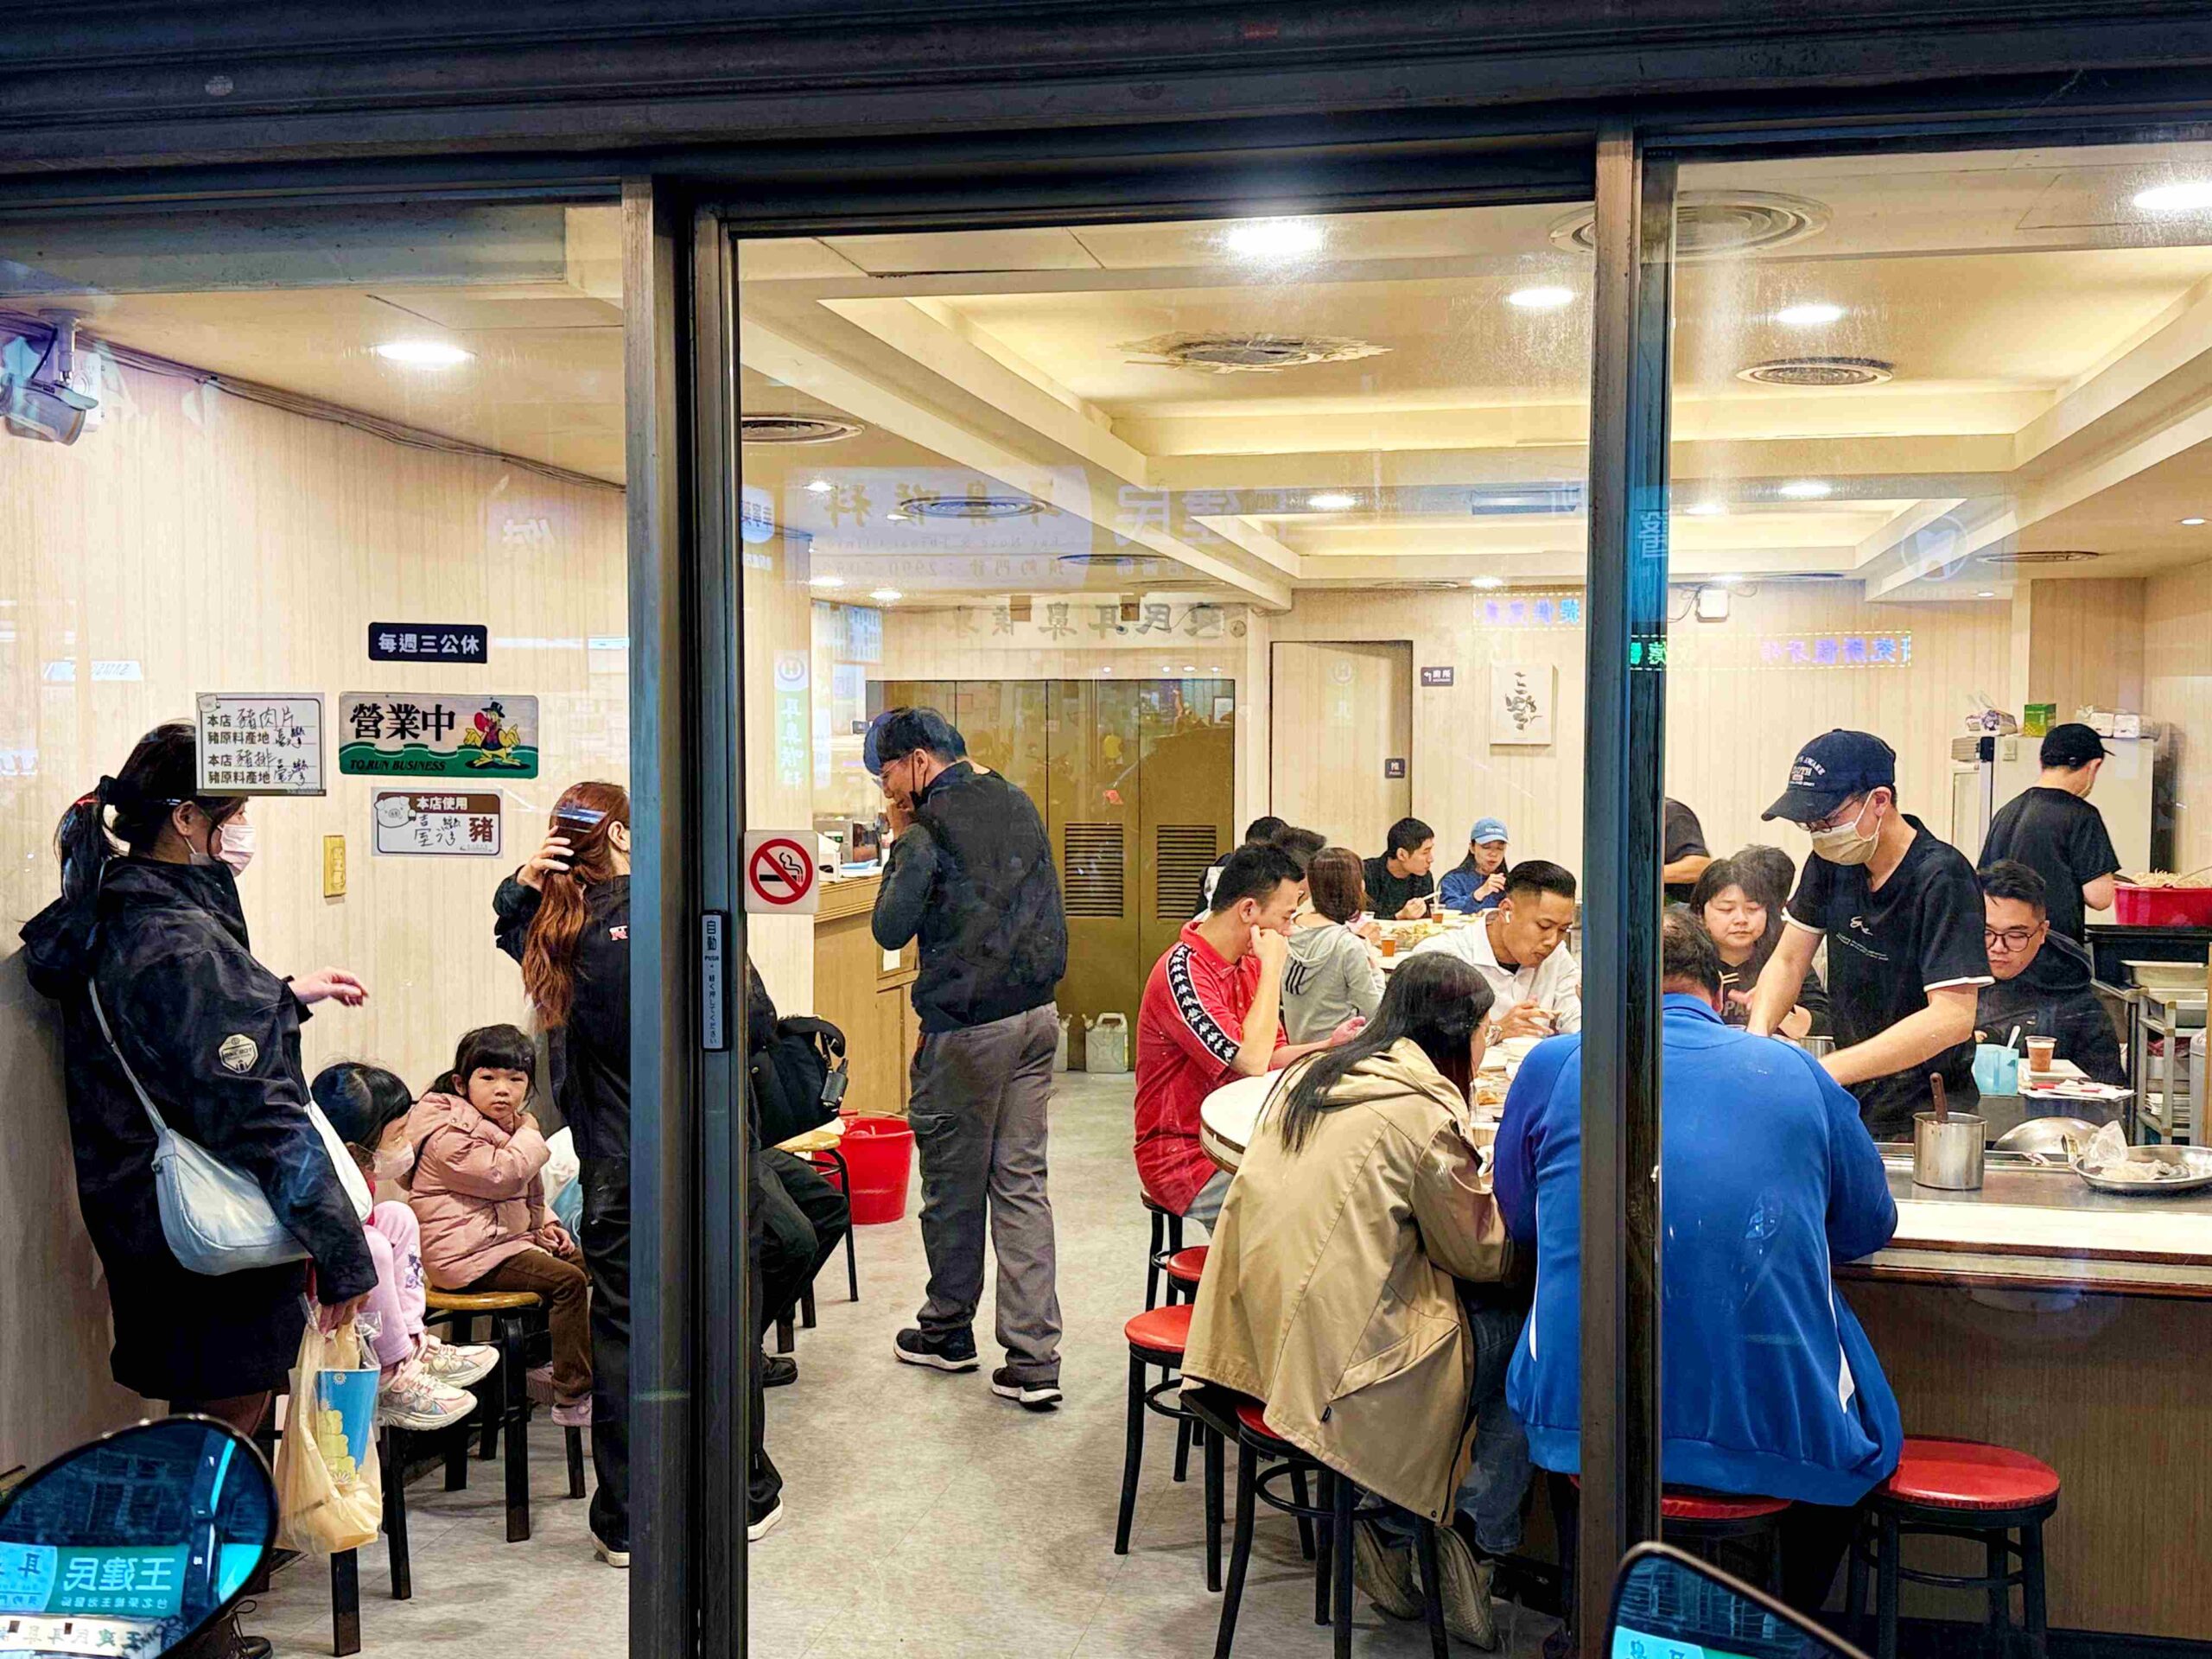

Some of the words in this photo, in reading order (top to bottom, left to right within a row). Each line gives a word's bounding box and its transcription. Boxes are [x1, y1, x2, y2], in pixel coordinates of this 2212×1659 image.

[378, 632, 480, 655] 每週三公休
[207, 714, 232, 728] 本店
[349, 702, 456, 741] 營業中
[207, 731, 270, 745] 豬原料產地
[207, 753, 232, 767] 本店
[350, 760, 365, 770] TO
[366, 760, 390, 770] RUN
[392, 760, 447, 772] BUSINESS
[207, 771, 271, 785] 豬原料產地
[416, 797, 468, 810] 本店使用
[468, 817, 494, 843] 豬
[706, 920, 717, 950] 自動
